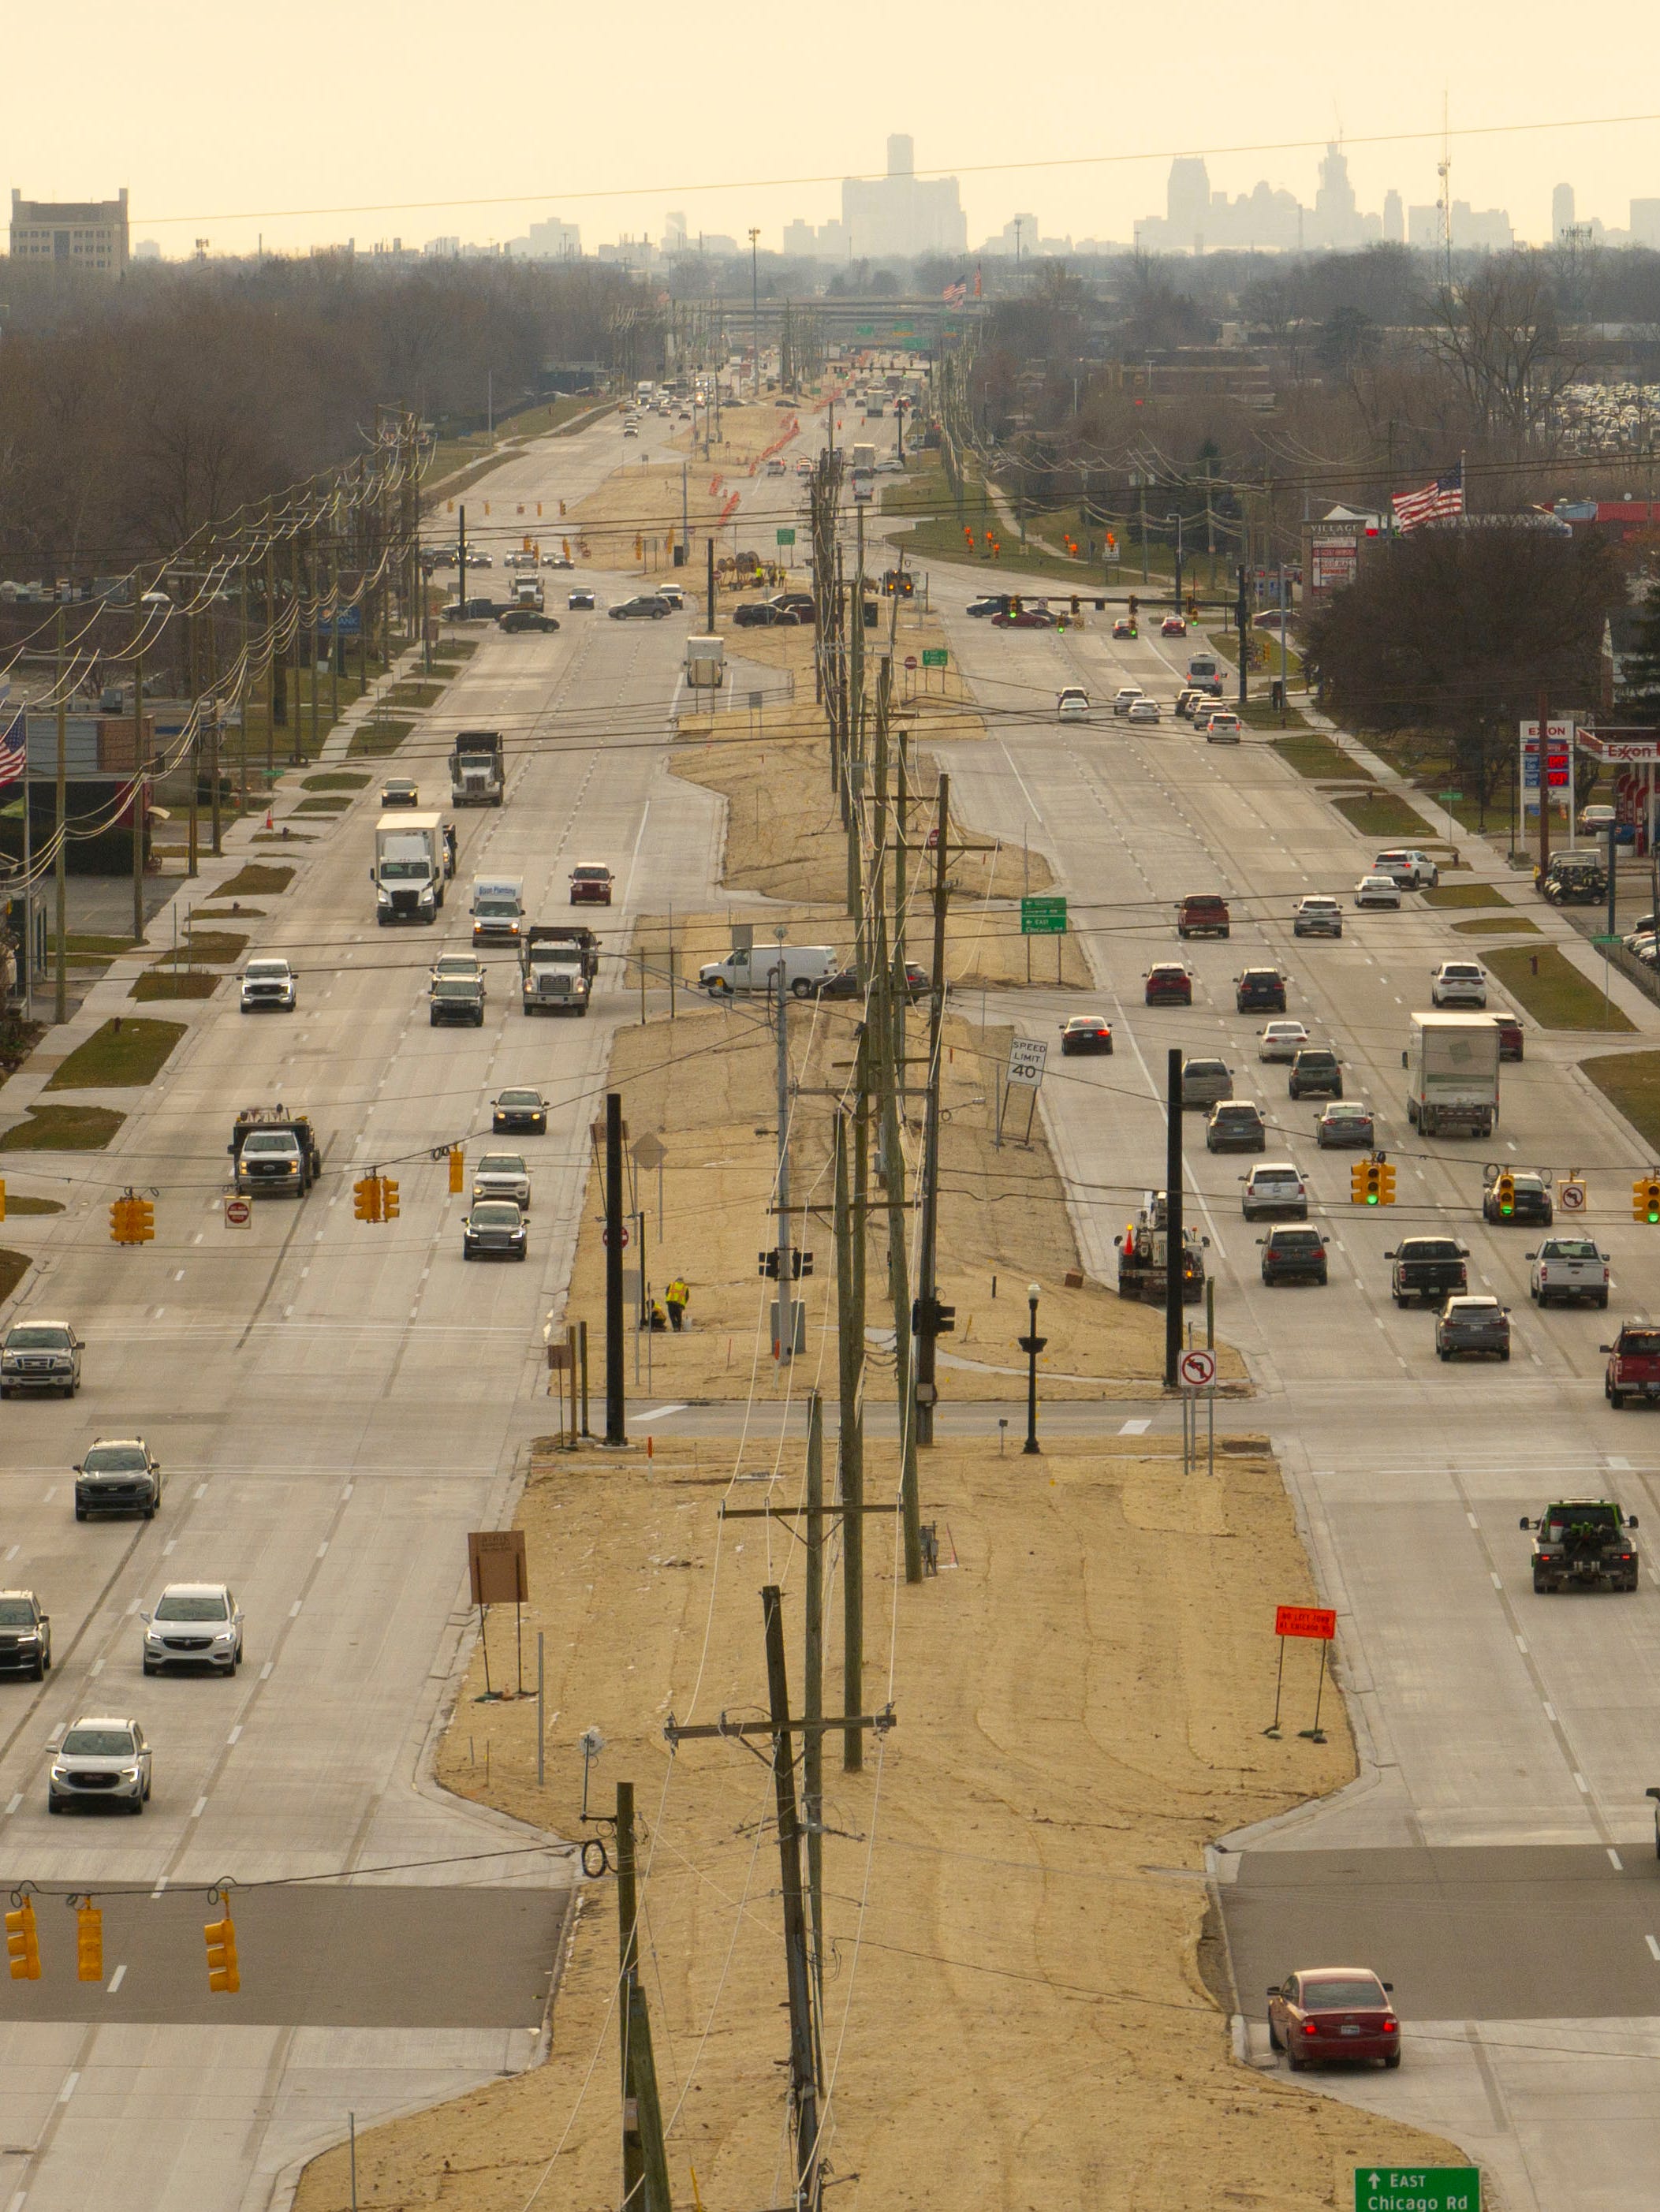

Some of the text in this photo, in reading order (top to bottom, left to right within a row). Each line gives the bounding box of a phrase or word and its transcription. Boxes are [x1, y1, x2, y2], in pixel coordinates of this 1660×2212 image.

[1528, 727, 1565, 736] EON
[1013, 1041, 1046, 1053] SPEED
[1014, 1052, 1041, 1062] LIMIT
[1013, 1065, 1035, 1078] 40
[1390, 2173, 1426, 2188] EAST
[1368, 2195, 1468, 2212] Chicago Rd
